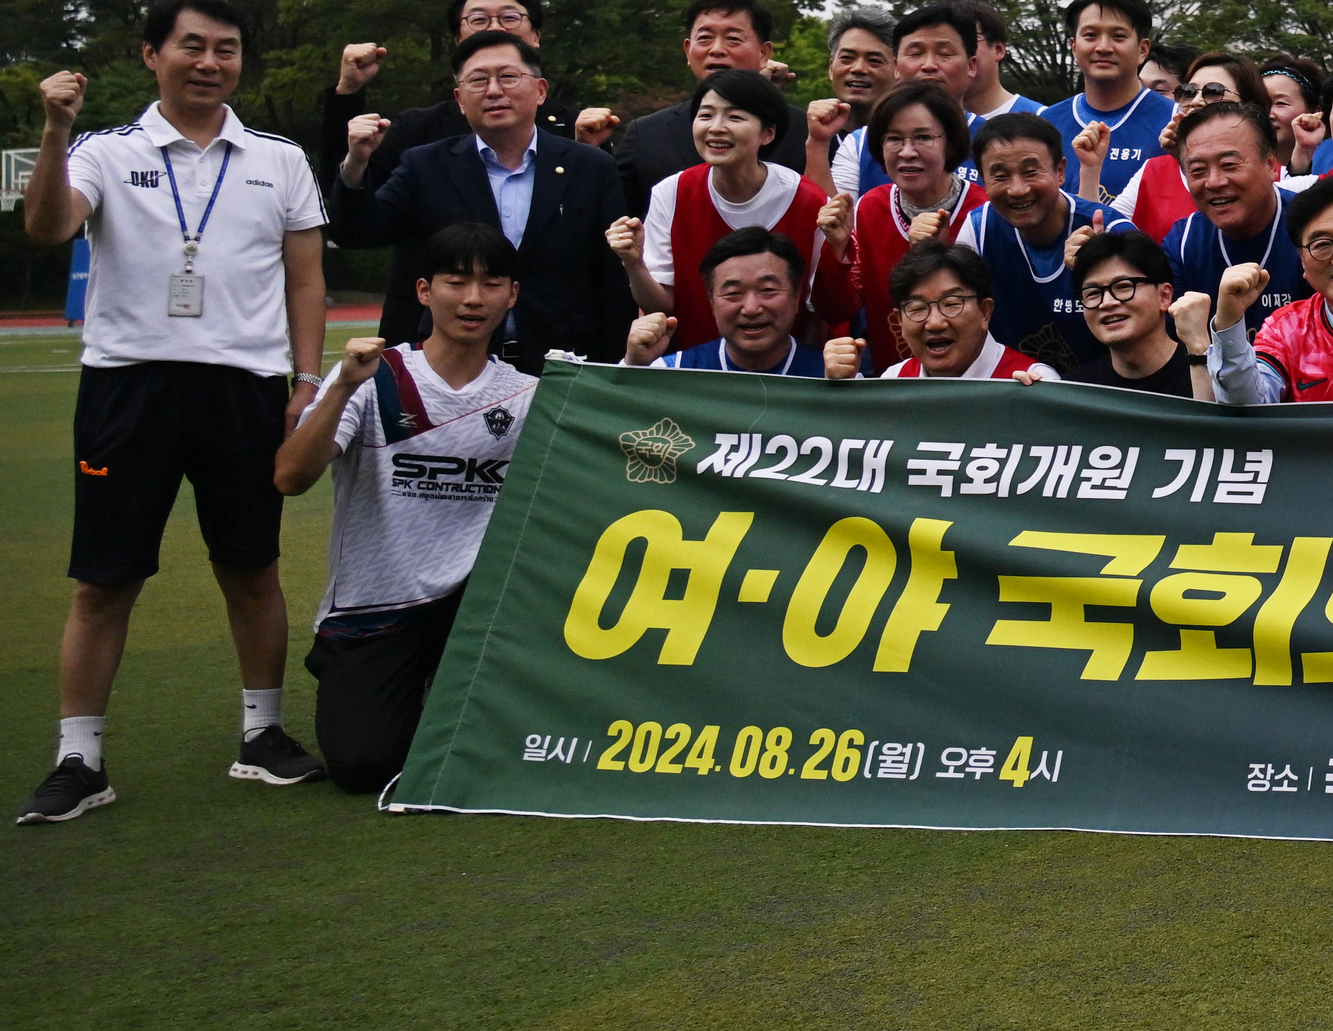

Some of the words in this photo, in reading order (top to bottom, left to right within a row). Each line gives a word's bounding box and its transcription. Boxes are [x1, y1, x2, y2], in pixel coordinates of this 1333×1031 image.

[1109, 148, 1142, 161] 전용기
[245, 179, 274, 188] adidas
[637, 440, 670, 459] 국회
[697, 432, 895, 494] 제22대
[906, 441, 1141, 499] 국회개원
[1151, 447, 1275, 505] 기념
[392, 478, 413, 489] SPK
[562, 509, 959, 673] 여·야
[522, 734, 579, 764] 일시
[1246, 763, 1298, 793] 장소
